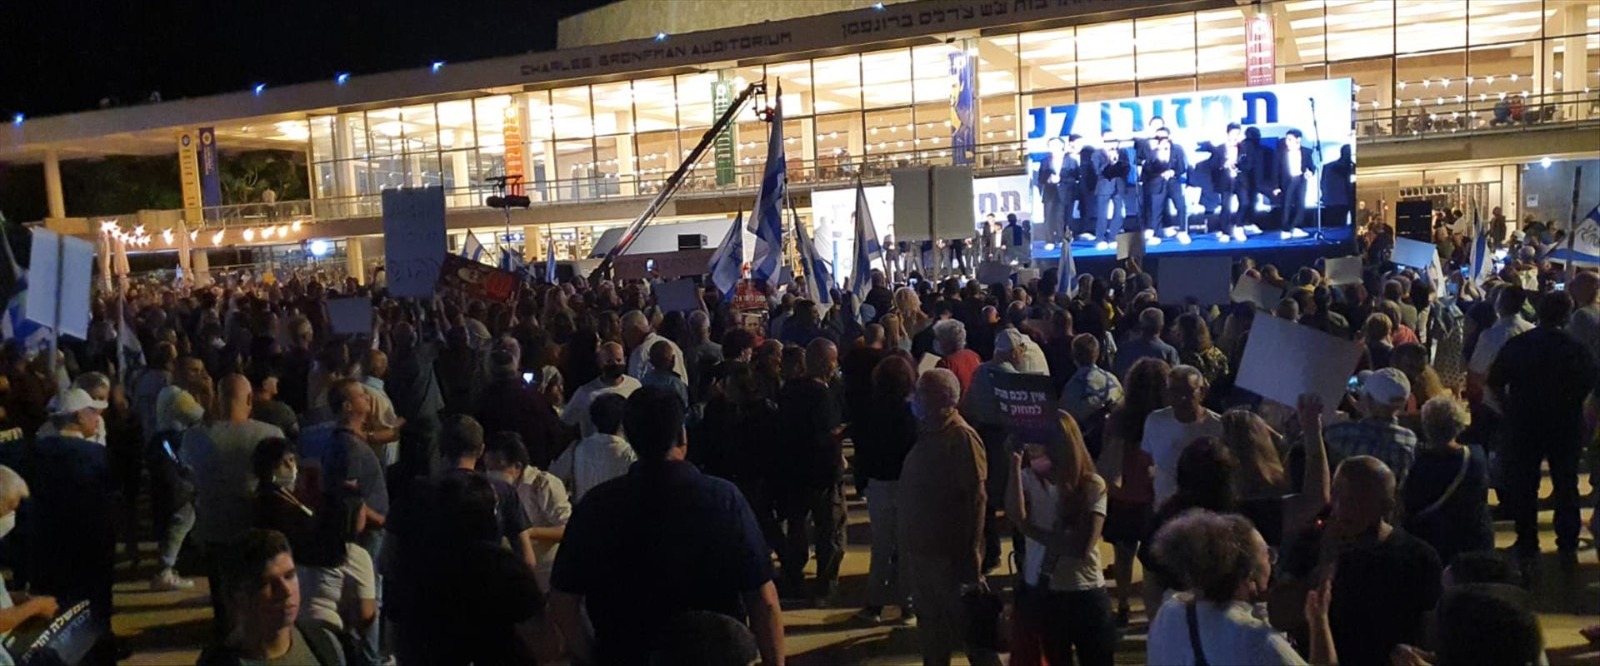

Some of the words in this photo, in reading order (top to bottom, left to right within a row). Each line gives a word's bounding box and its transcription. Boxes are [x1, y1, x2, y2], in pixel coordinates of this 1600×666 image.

[842, 15, 914, 40] ברונפמן
[691, 31, 793, 56] AUDITORIUM
[1030, 391, 1047, 402] אין
[1010, 404, 1042, 415] למחוק
